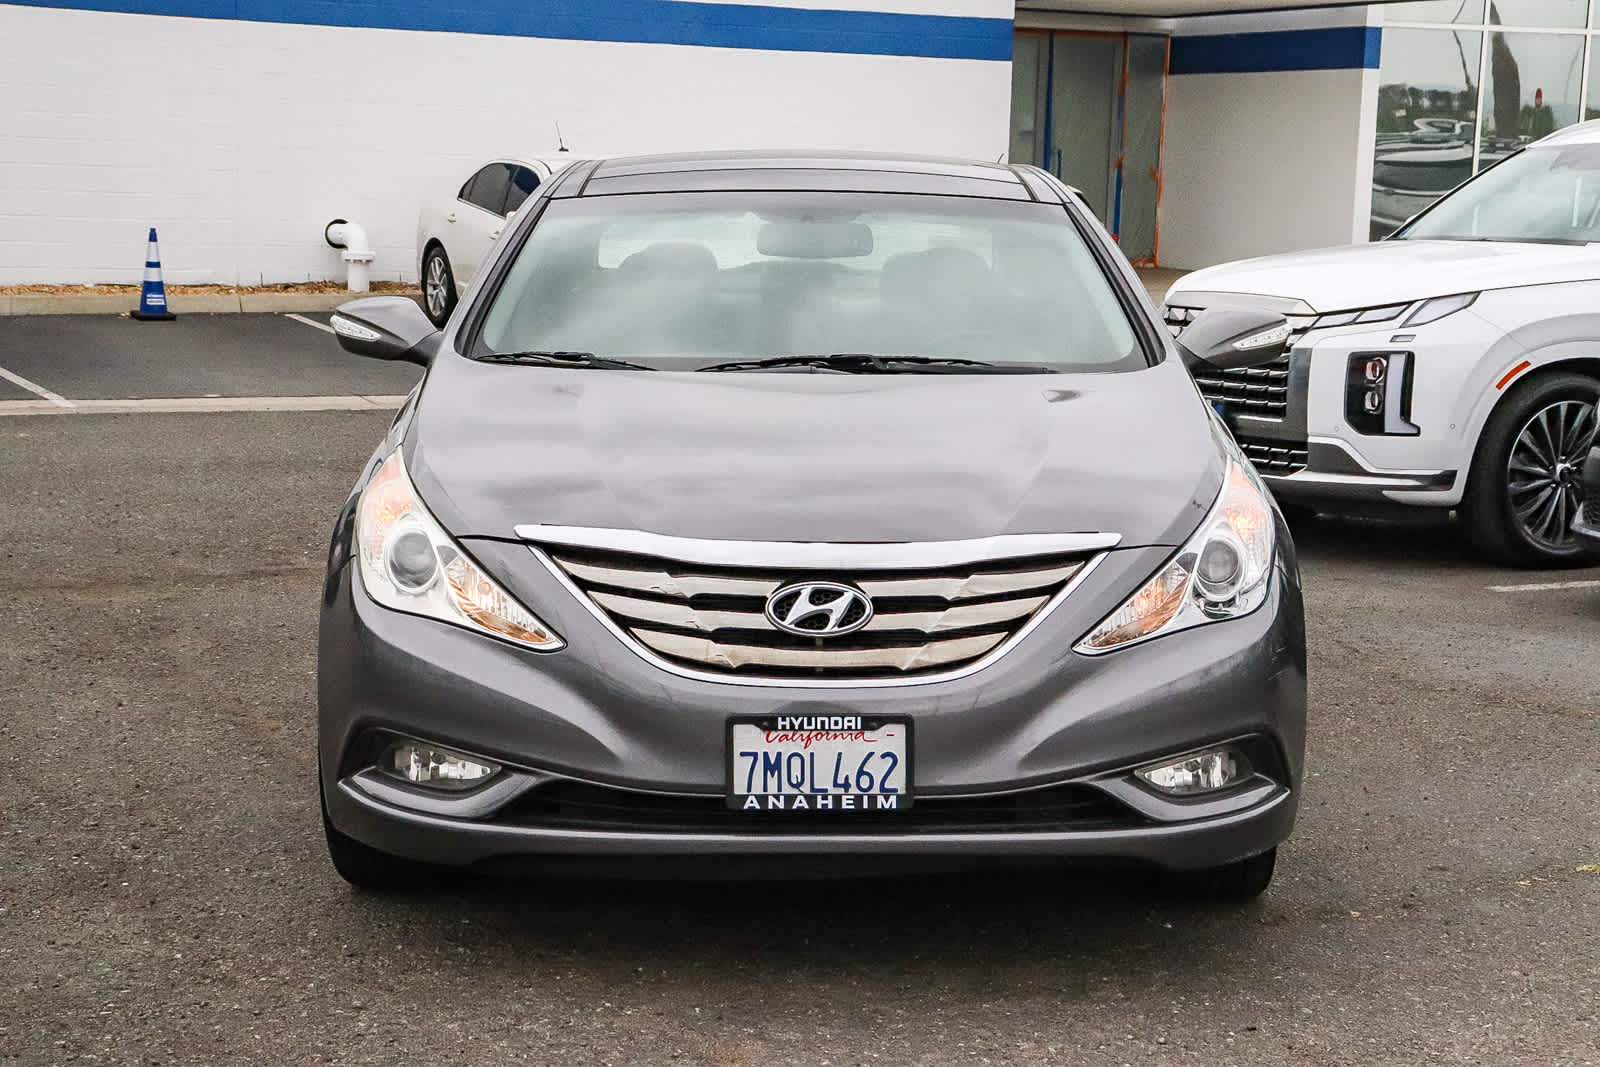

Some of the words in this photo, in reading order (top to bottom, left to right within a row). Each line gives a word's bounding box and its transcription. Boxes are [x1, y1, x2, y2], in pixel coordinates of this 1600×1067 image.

[777, 716, 861, 730] HYUNDAI
[739, 751, 899, 793] 7MQL462
[743, 795, 897, 810] ANAHEIM
